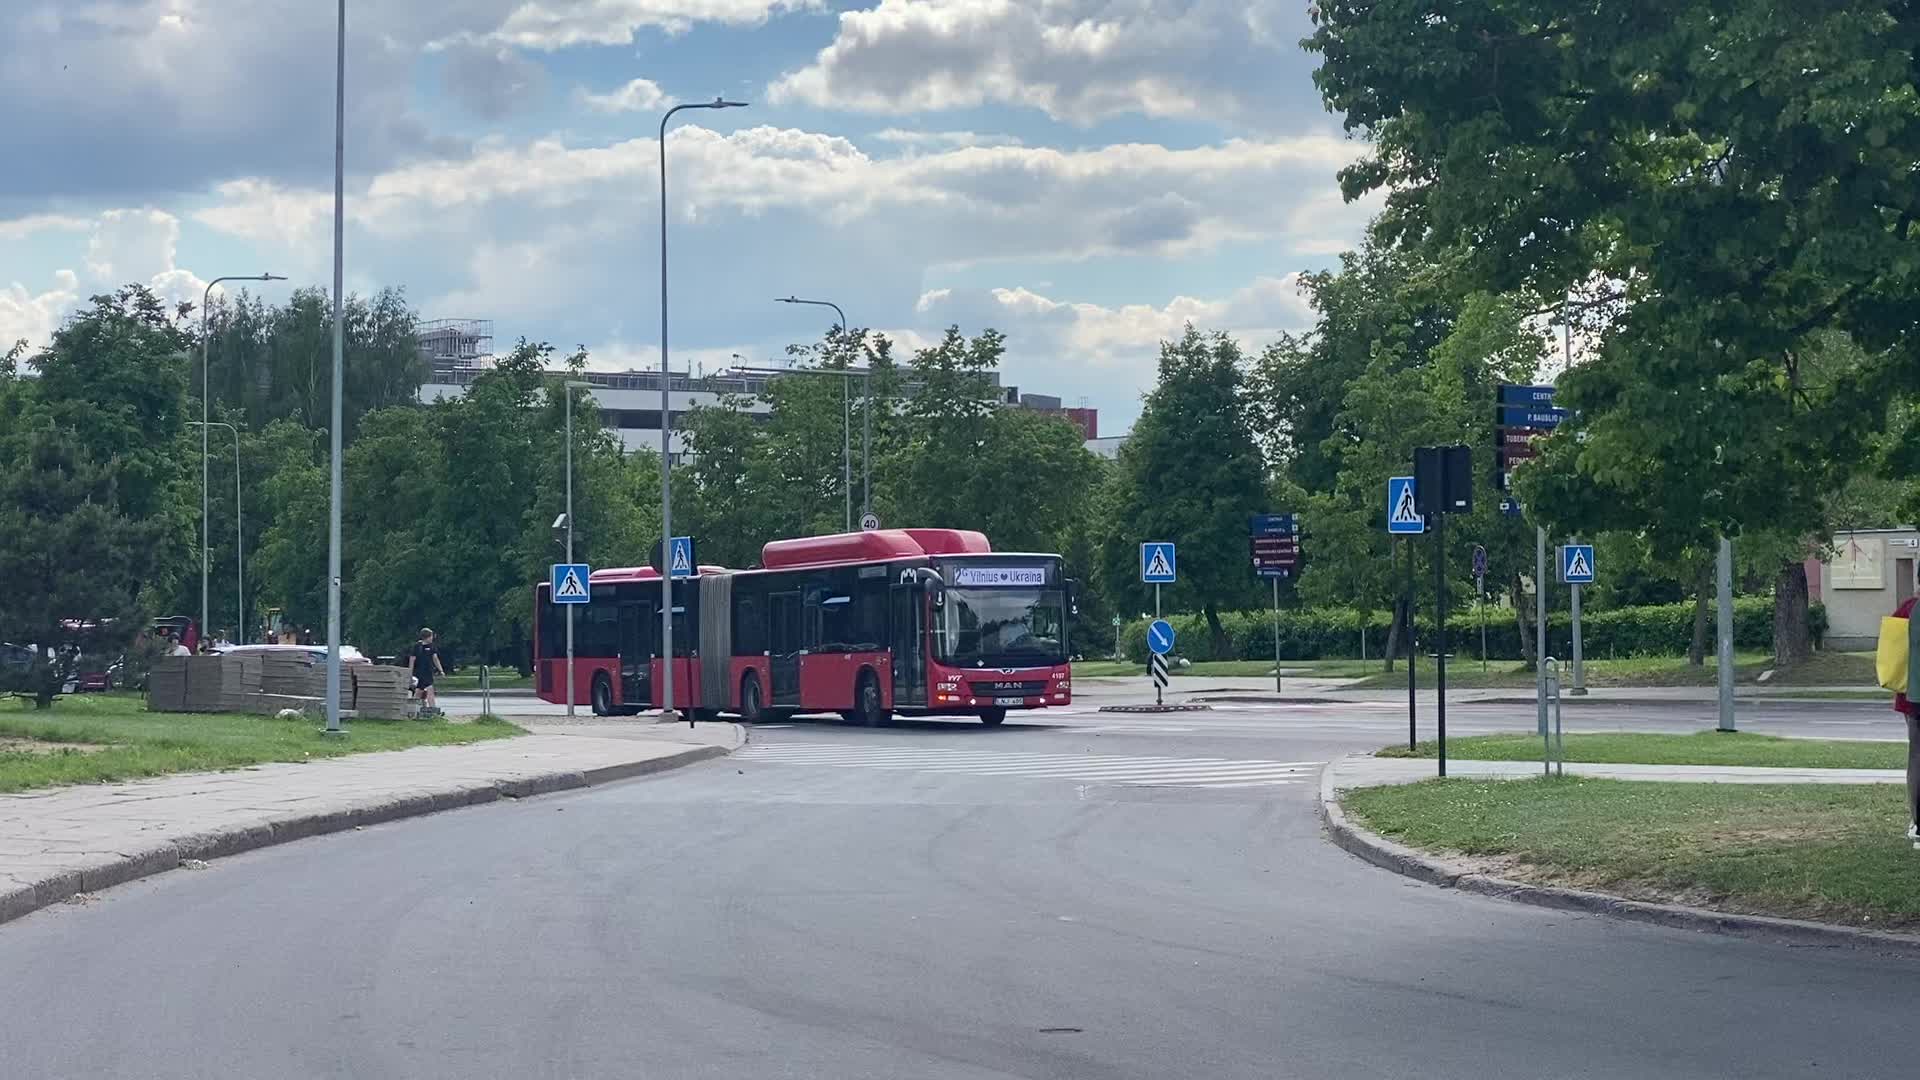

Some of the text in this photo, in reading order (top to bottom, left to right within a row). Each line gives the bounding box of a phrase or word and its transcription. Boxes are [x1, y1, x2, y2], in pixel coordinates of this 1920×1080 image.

[864, 519, 876, 529] 40
[970, 570, 998, 584] Vilnius
[1009, 570, 1042, 584] Ukraina
